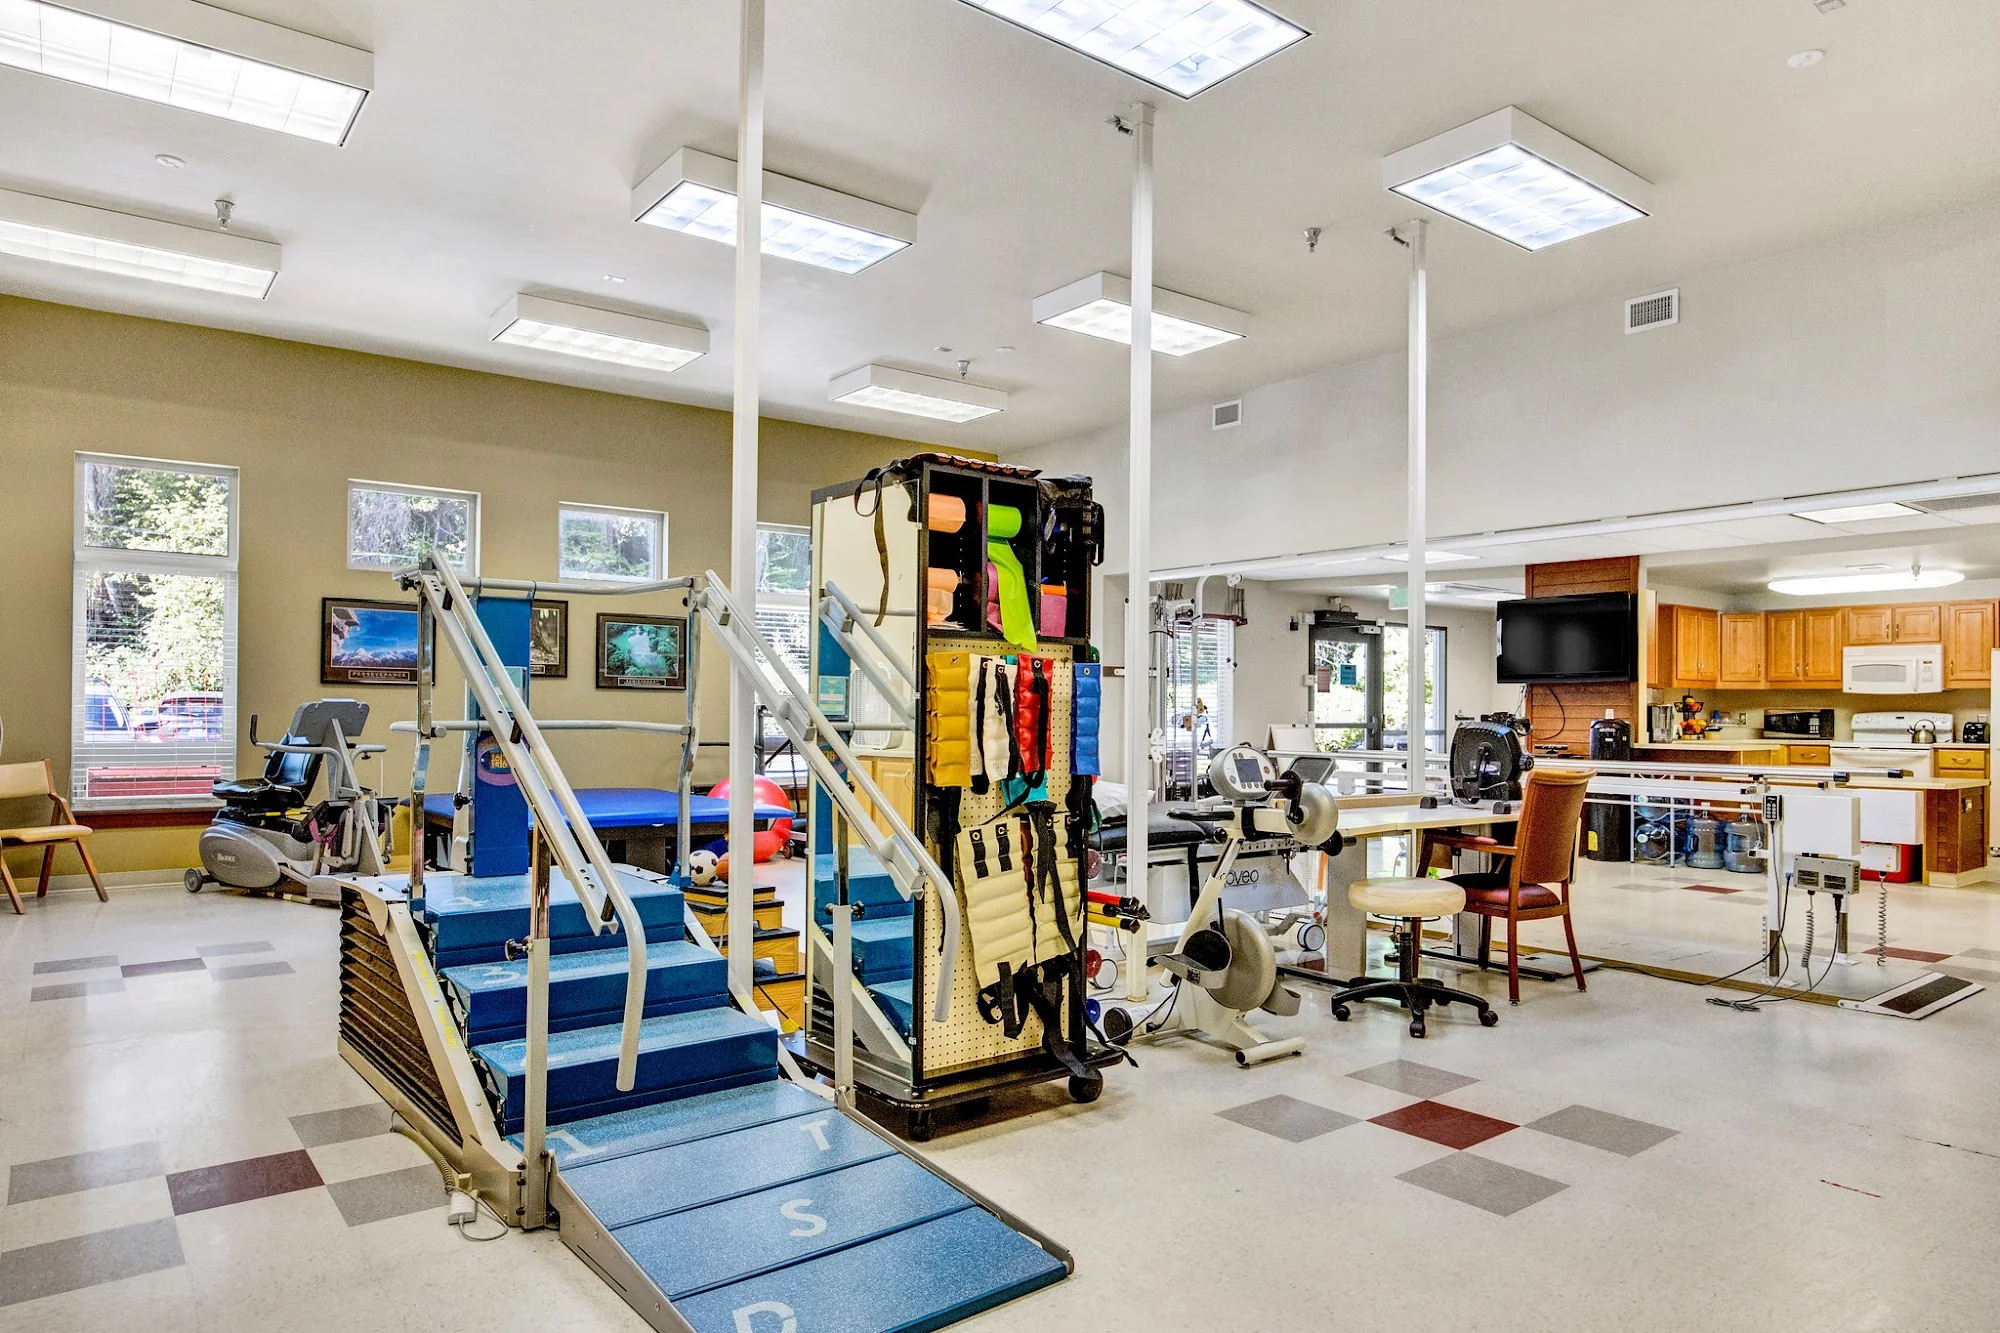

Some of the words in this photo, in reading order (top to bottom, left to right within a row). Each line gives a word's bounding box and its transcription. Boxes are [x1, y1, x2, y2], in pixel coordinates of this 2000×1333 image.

[469, 965, 521, 985] 3
[545, 1129, 608, 1160] 1
[800, 1119, 831, 1151] T
[780, 1199, 828, 1237] S
[732, 1301, 798, 1333] D
